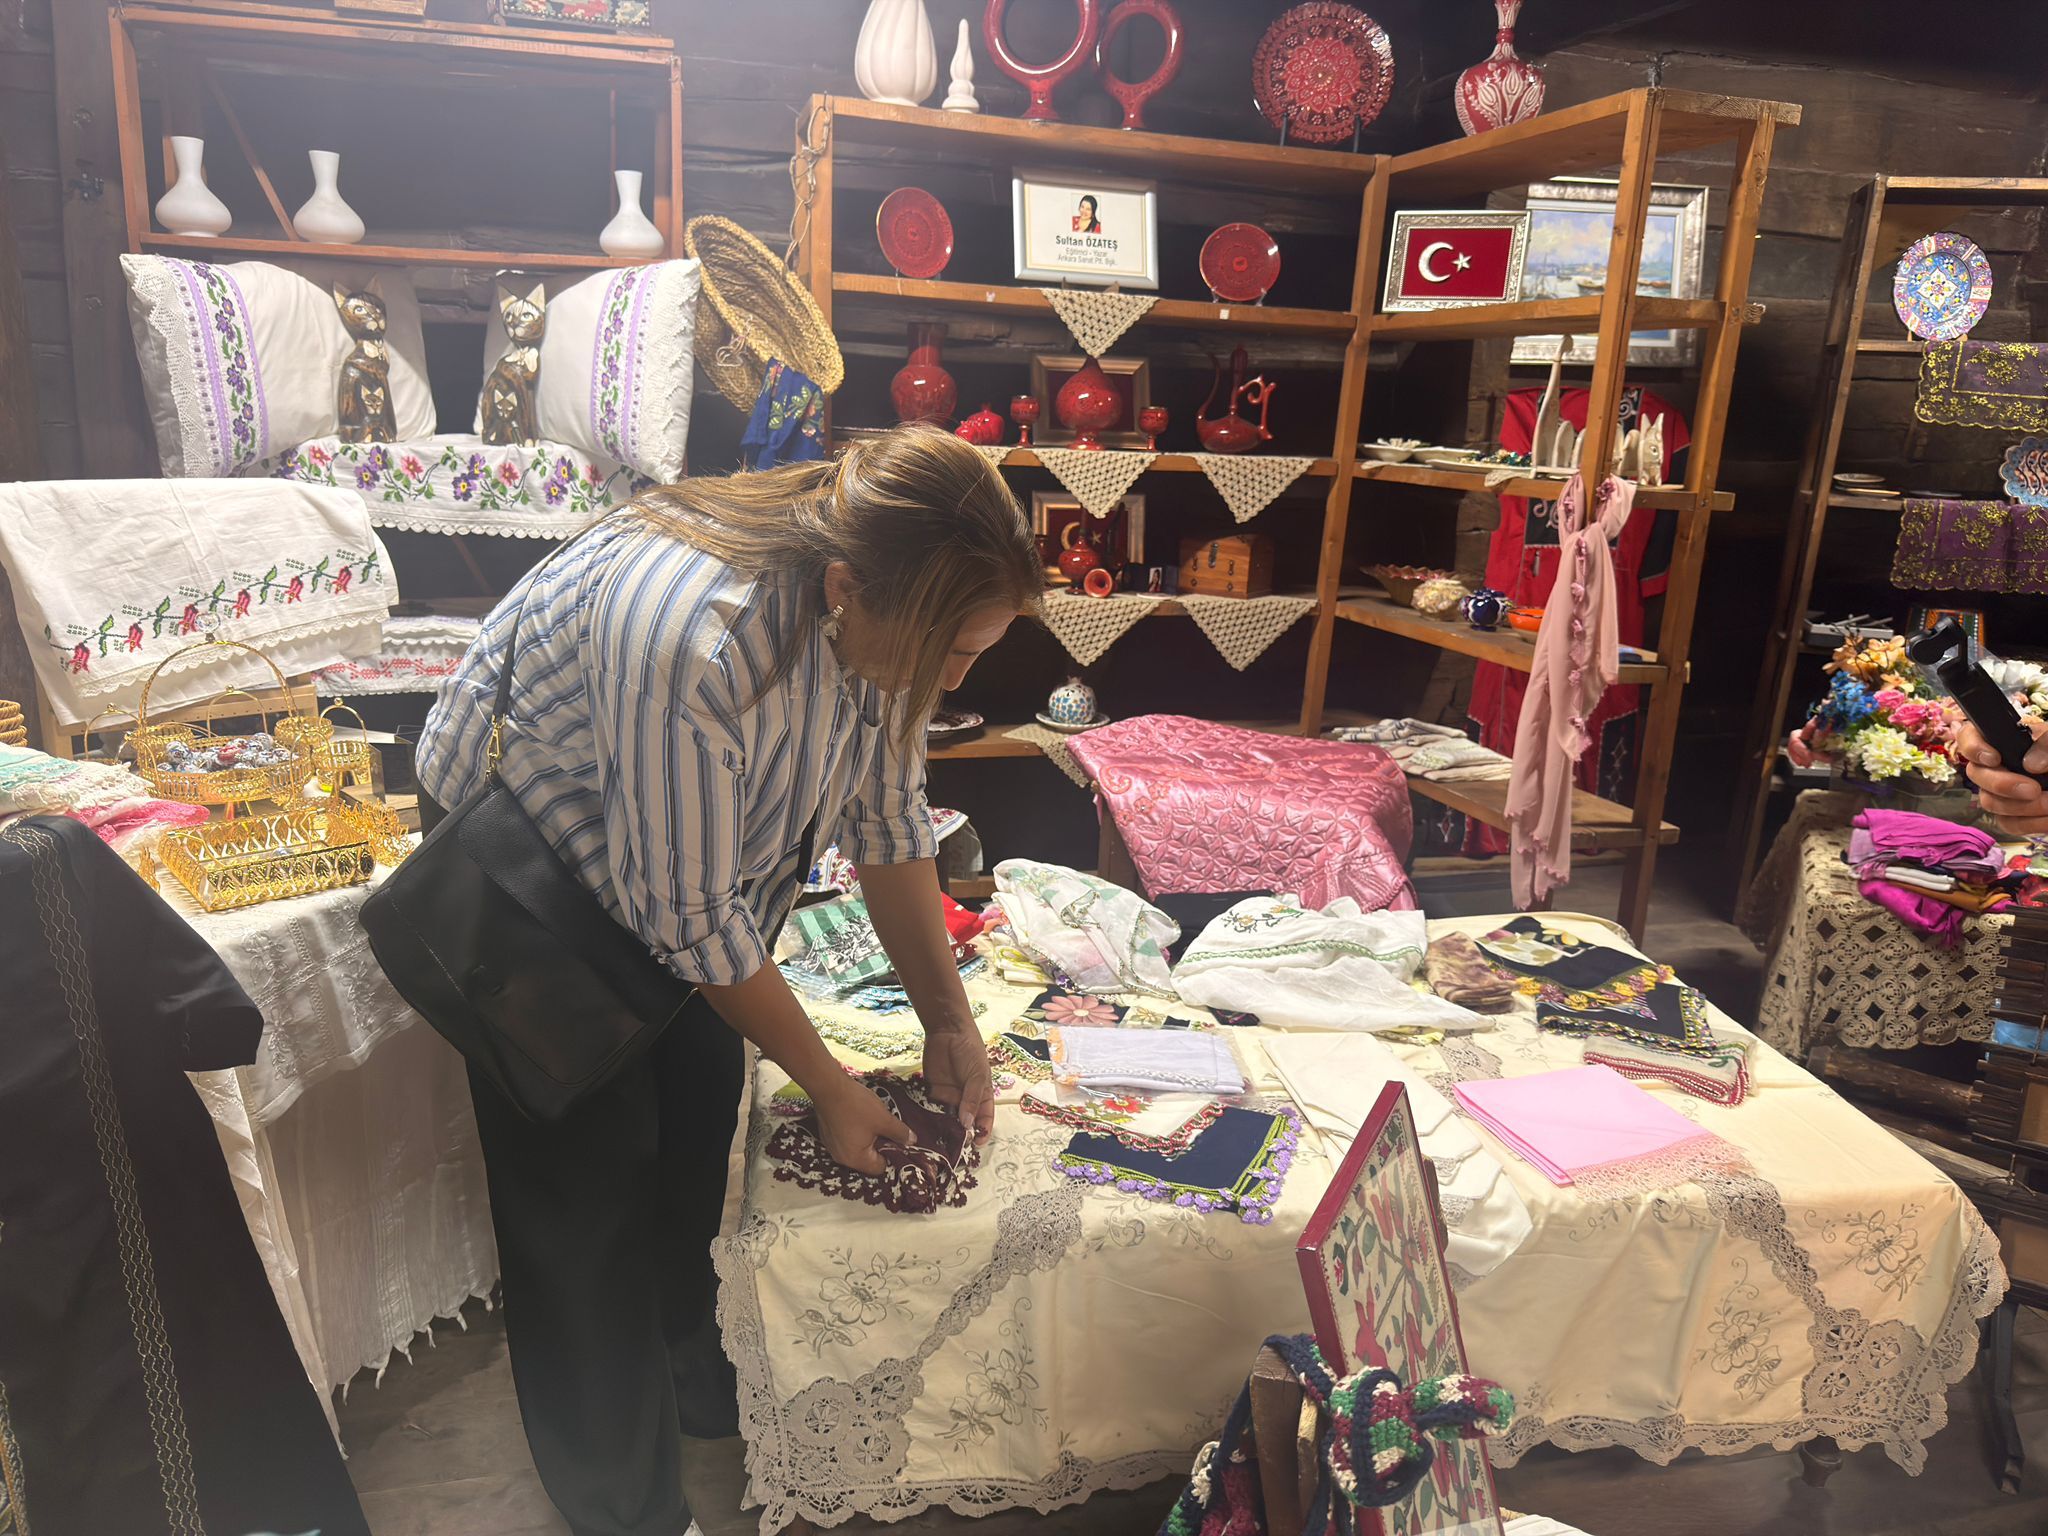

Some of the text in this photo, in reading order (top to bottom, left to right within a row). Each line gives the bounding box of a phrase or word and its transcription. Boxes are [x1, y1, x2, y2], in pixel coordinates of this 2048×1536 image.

[1055, 235, 1118, 252] Sultan ÖZATEŞ
[1058, 253, 1077, 262] Ankara
